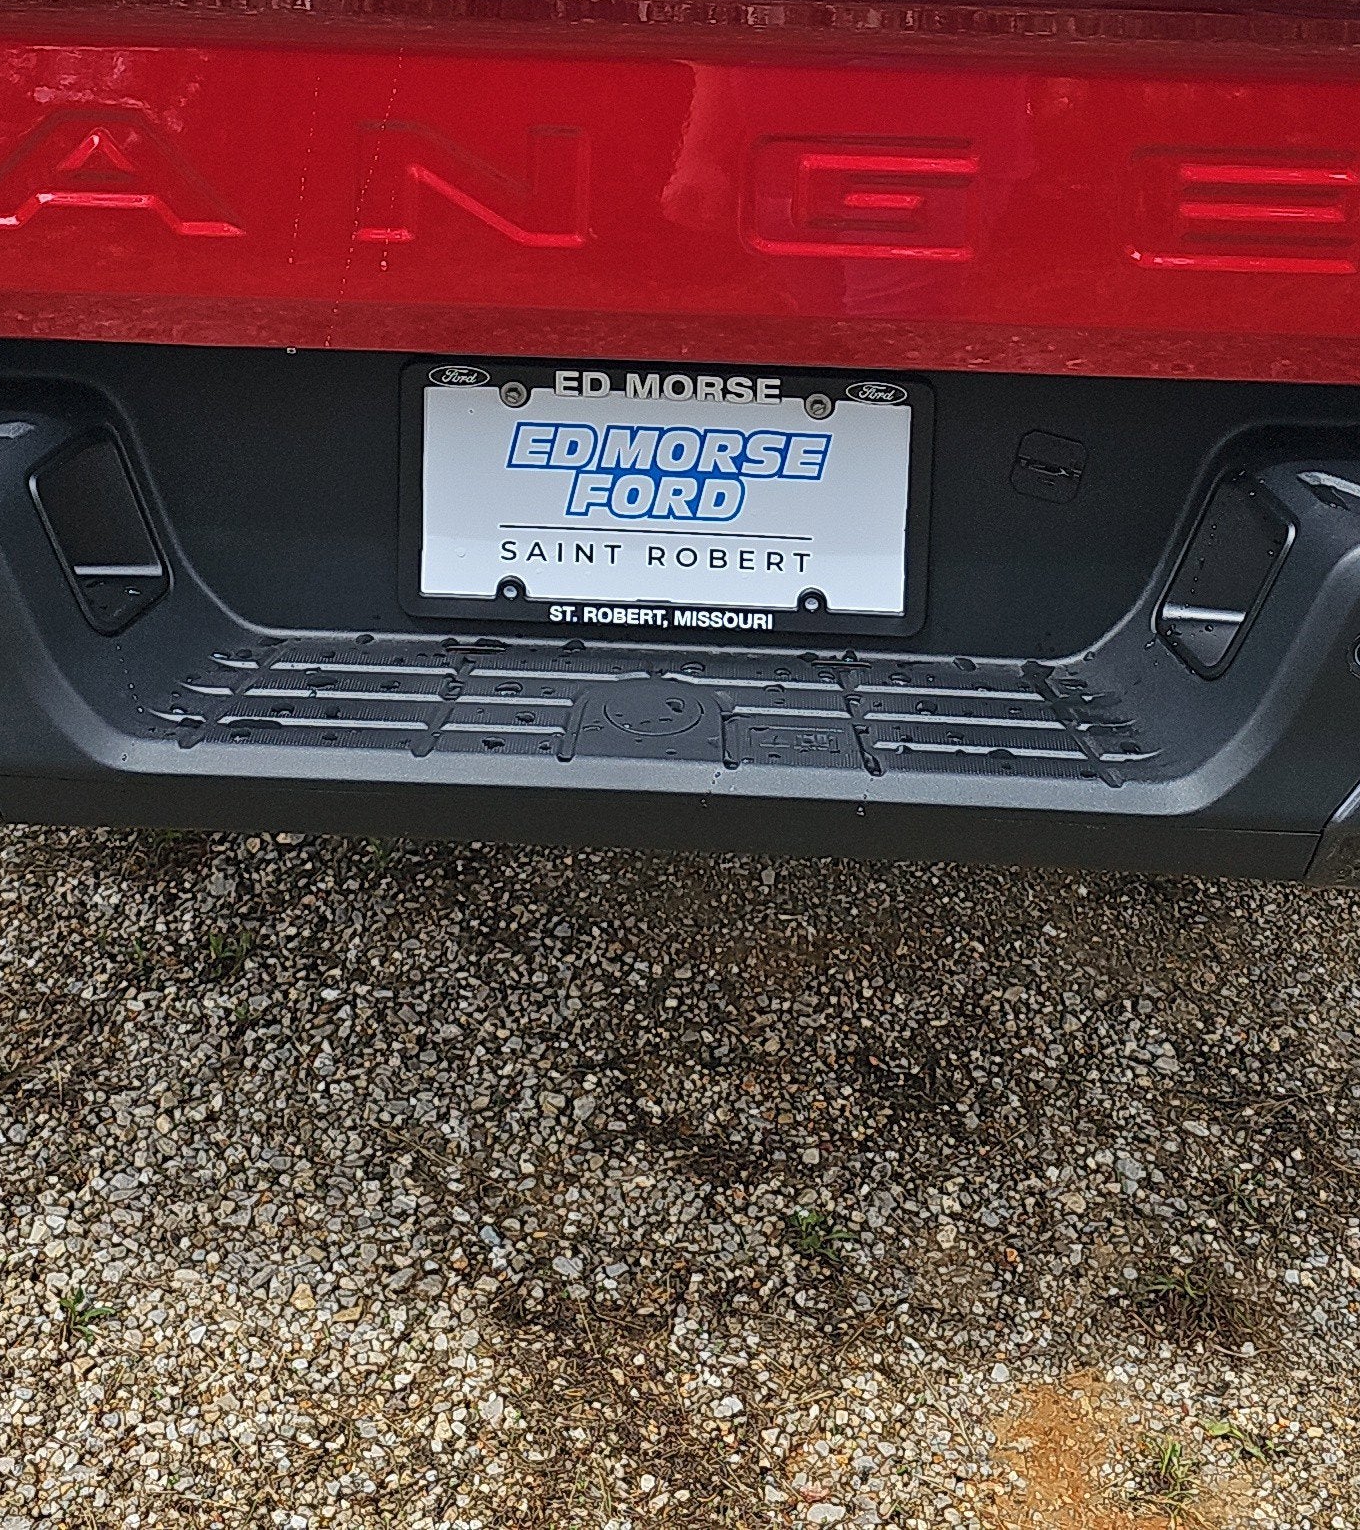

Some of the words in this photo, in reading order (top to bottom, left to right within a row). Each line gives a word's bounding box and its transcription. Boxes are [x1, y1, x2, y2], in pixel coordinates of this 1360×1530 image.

[441, 368, 477, 384] Ford
[554, 371, 611, 398] ED
[626, 372, 782, 405] MORSE
[858, 385, 895, 401] Ford
[507, 422, 597, 470] ED
[598, 425, 833, 481] MORSE
[565, 471, 747, 522] FORD
[500, 540, 623, 566] SAINT
[648, 546, 813, 573] ROBERT
[549, 605, 578, 622] ST.
[583, 607, 668, 628] ROBERT,
[673, 610, 773, 630] MISSOURI
